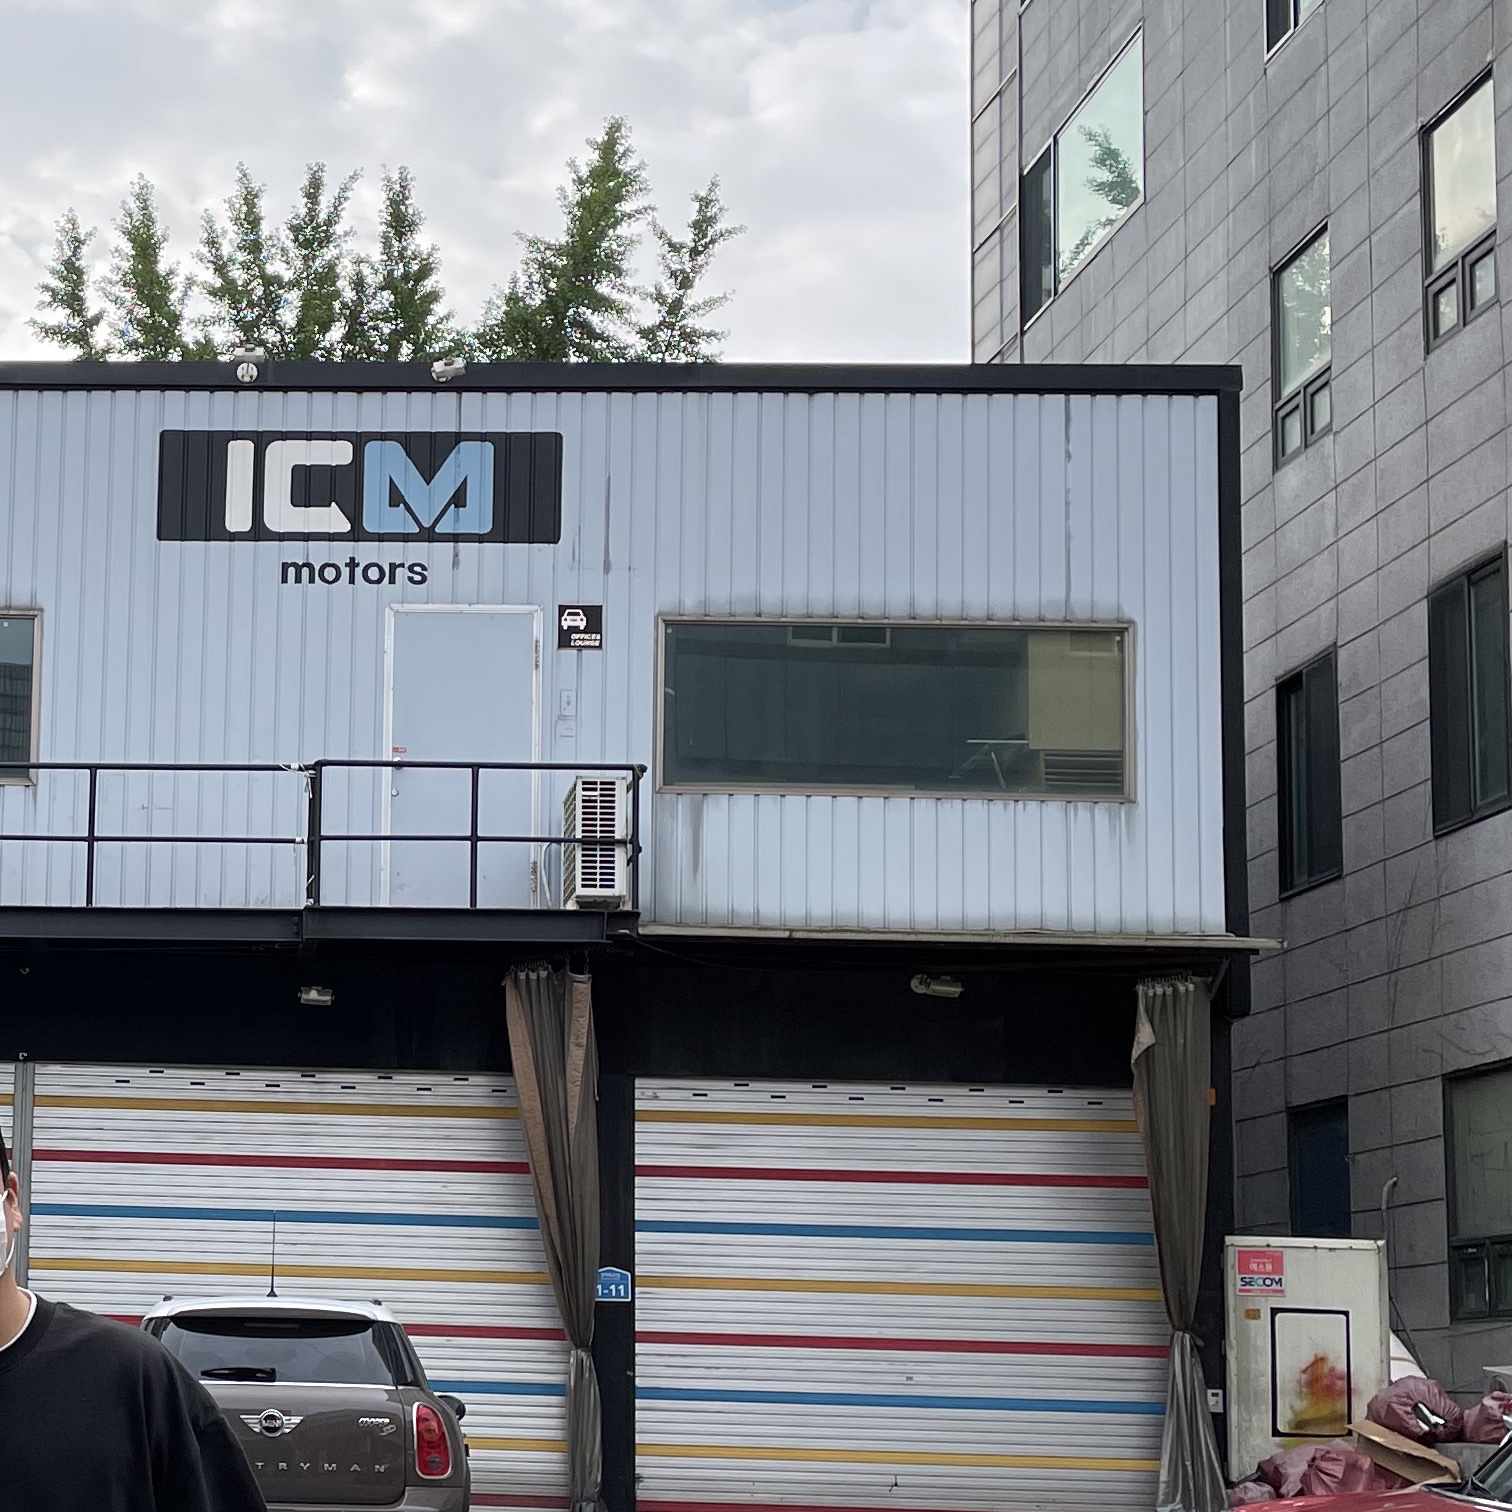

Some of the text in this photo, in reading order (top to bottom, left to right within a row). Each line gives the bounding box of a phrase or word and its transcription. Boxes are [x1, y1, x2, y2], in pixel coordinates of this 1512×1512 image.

[225, 440, 495, 534] ICM
[281, 556, 428, 586] motors
[1239, 1276, 1283, 1288] SECOM
[254, 1462, 386, 1473] TRYMAN
